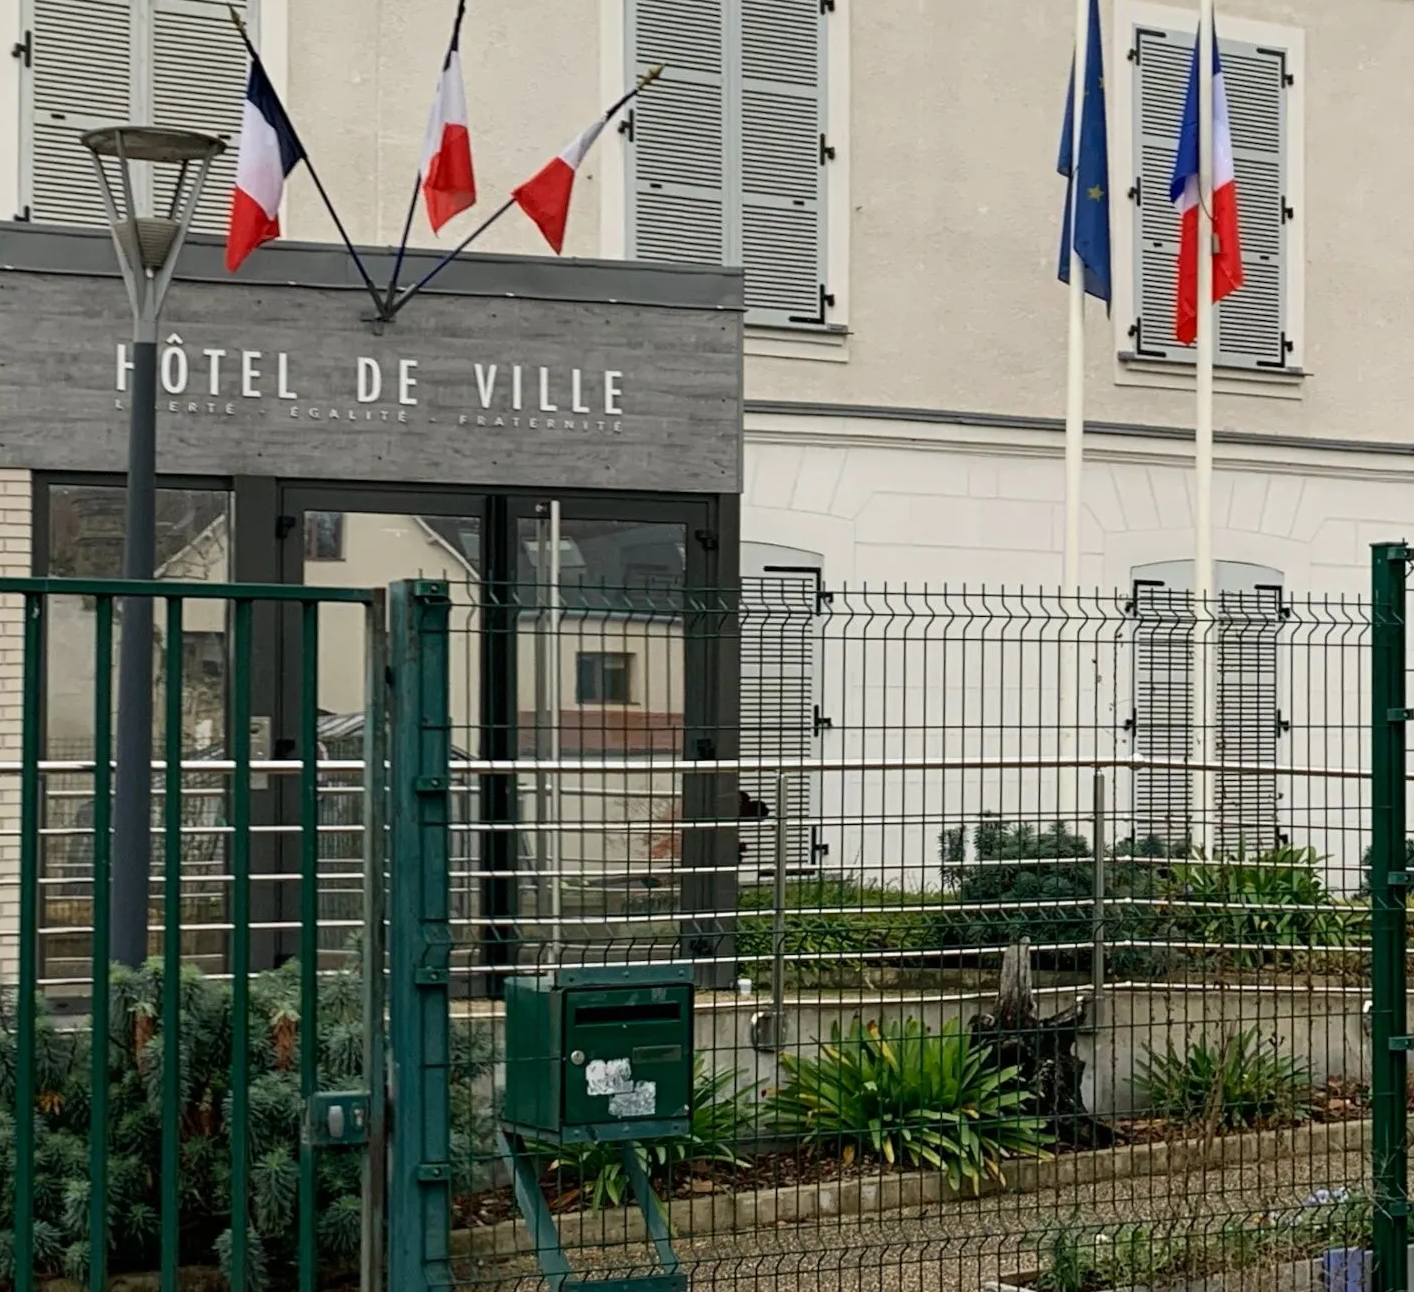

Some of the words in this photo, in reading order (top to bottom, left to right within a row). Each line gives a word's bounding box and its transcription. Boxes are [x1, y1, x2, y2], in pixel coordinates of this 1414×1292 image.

[116, 332, 298, 399] HÔTEL
[356, 357, 418, 405] DE
[474, 363, 623, 415] VILLE
[114, 398, 235, 415] LERTÉ
[289, 405, 407, 424] ÉGALITÉ
[458, 414, 623, 433] FRATERNITÉ
